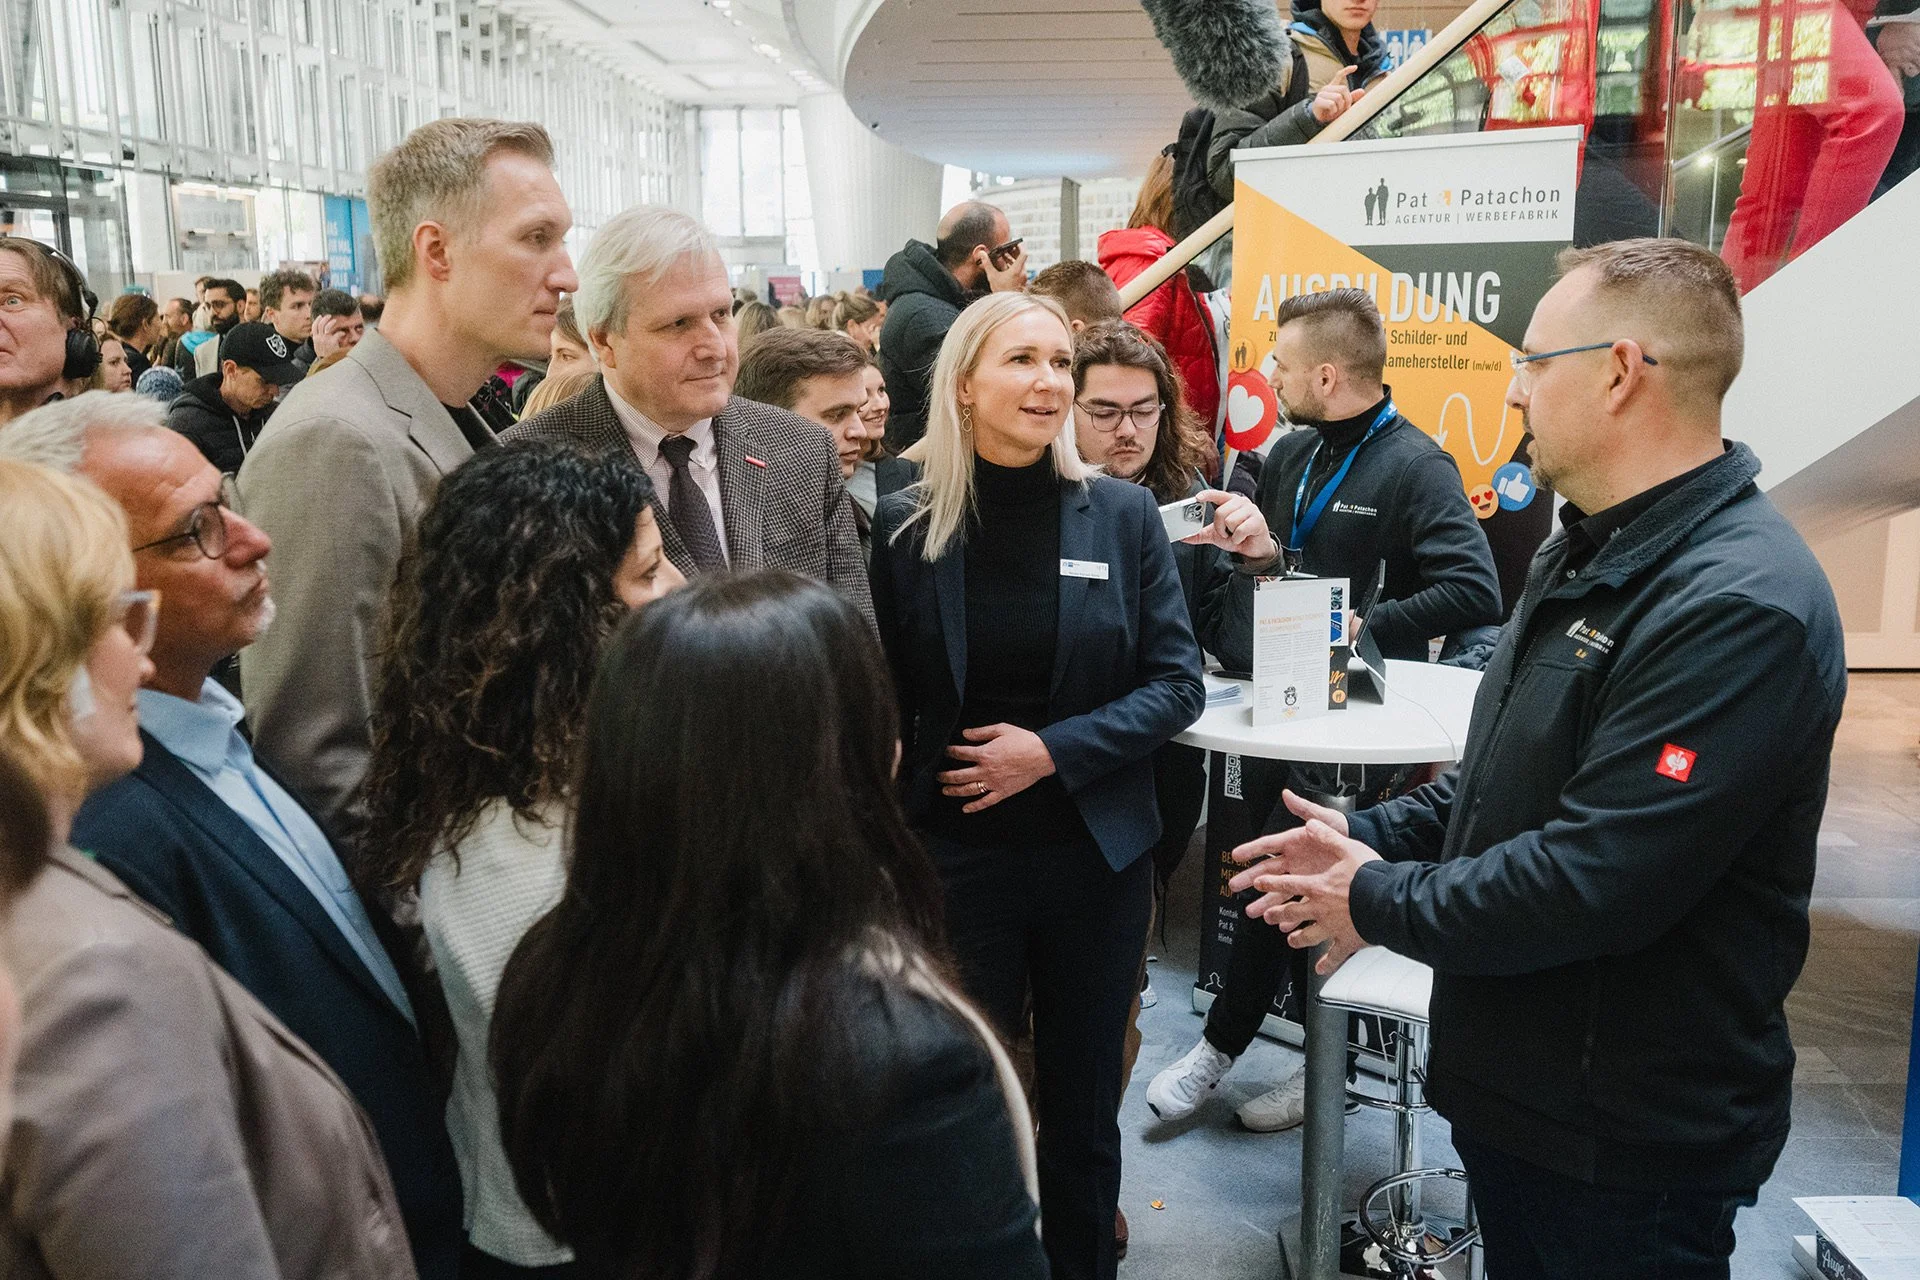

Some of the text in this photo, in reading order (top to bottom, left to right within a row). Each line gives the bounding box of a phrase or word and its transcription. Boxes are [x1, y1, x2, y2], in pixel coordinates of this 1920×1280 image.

[1396, 186, 1561, 208] Pat Patachon
[1395, 209, 1559, 225] AGENTUR WERBEFABRIK
[1391, 329, 1442, 345] Schilder-
[1446, 330, 1468, 346] und
[1472, 360, 1502, 372] (m/w/d)
